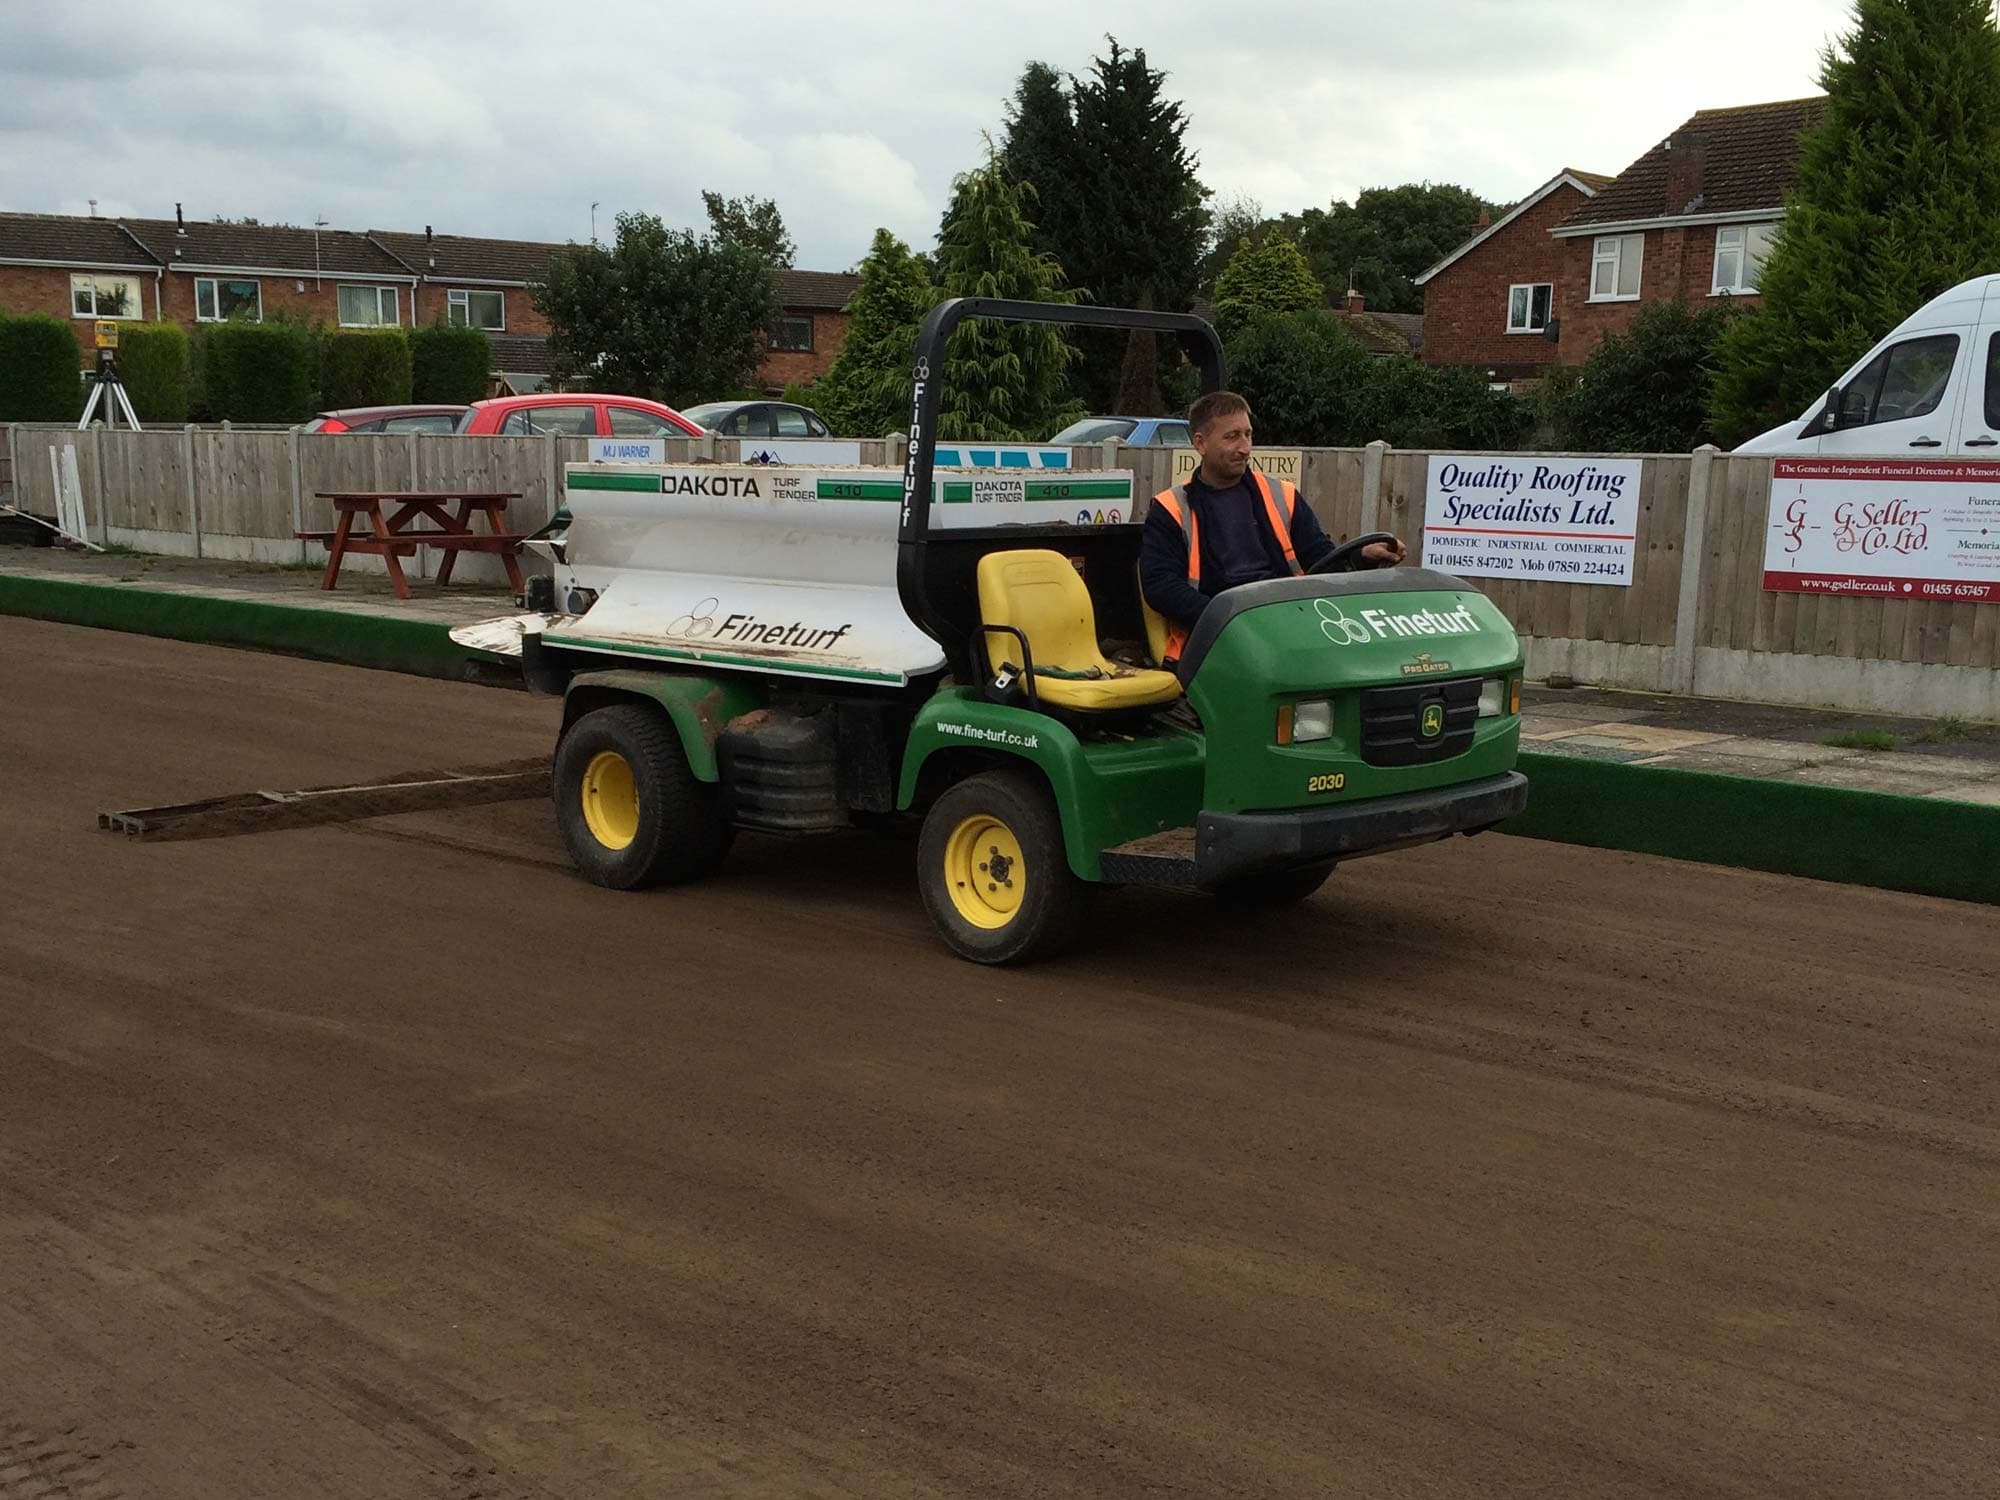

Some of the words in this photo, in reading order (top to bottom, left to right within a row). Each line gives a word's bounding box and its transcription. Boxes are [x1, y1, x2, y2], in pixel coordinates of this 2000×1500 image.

[618, 446, 650, 458] WARNER
[902, 382, 925, 527] Fineturf
[1780, 464, 1796, 473] The
[1797, 465, 1830, 474] Genuine
[1832, 466, 1881, 476] Independent
[1882, 466, 1914, 474] Funeral
[1916, 466, 1954, 476] Directors
[661, 476, 760, 498] DAKOTA
[773, 478, 800, 487] TURF
[834, 486, 862, 496] 410
[975, 481, 1022, 492] DAKOTA
[1042, 486, 1070, 497] 410
[1439, 463, 1524, 495] Quality
[1528, 465, 1626, 498] Roofing
[773, 490, 816, 500] TENDER
[975, 493, 993, 503] TURF
[996, 493, 1022, 502] TENDER
[1443, 495, 1562, 525] Specialists
[1567, 500, 1615, 525] Ltd.
[1432, 536, 1481, 548] DOMESTIC
[1488, 539, 1548, 551] INDUSTRIAL
[1555, 542, 1626, 555] COMMERCIAL
[1428, 553, 1443, 565] Tel
[1446, 555, 1474, 567] 01455
[1477, 557, 1513, 570] 847202
[1520, 558, 1545, 572] Mob
[1547, 561, 1580, 573] 07850
[1583, 563, 1625, 576] 224424
[1801, 578, 1896, 592] www.gseller.co.uk
[1922, 584, 1952, 594] 01455
[1954, 585, 1990, 596] 637457
[1360, 604, 1480, 638] Fineturf
[712, 614, 852, 650] Fineturf
[937, 722, 1038, 748] www.fine-turf.co.uk
[1308, 773, 1344, 792] 2030
